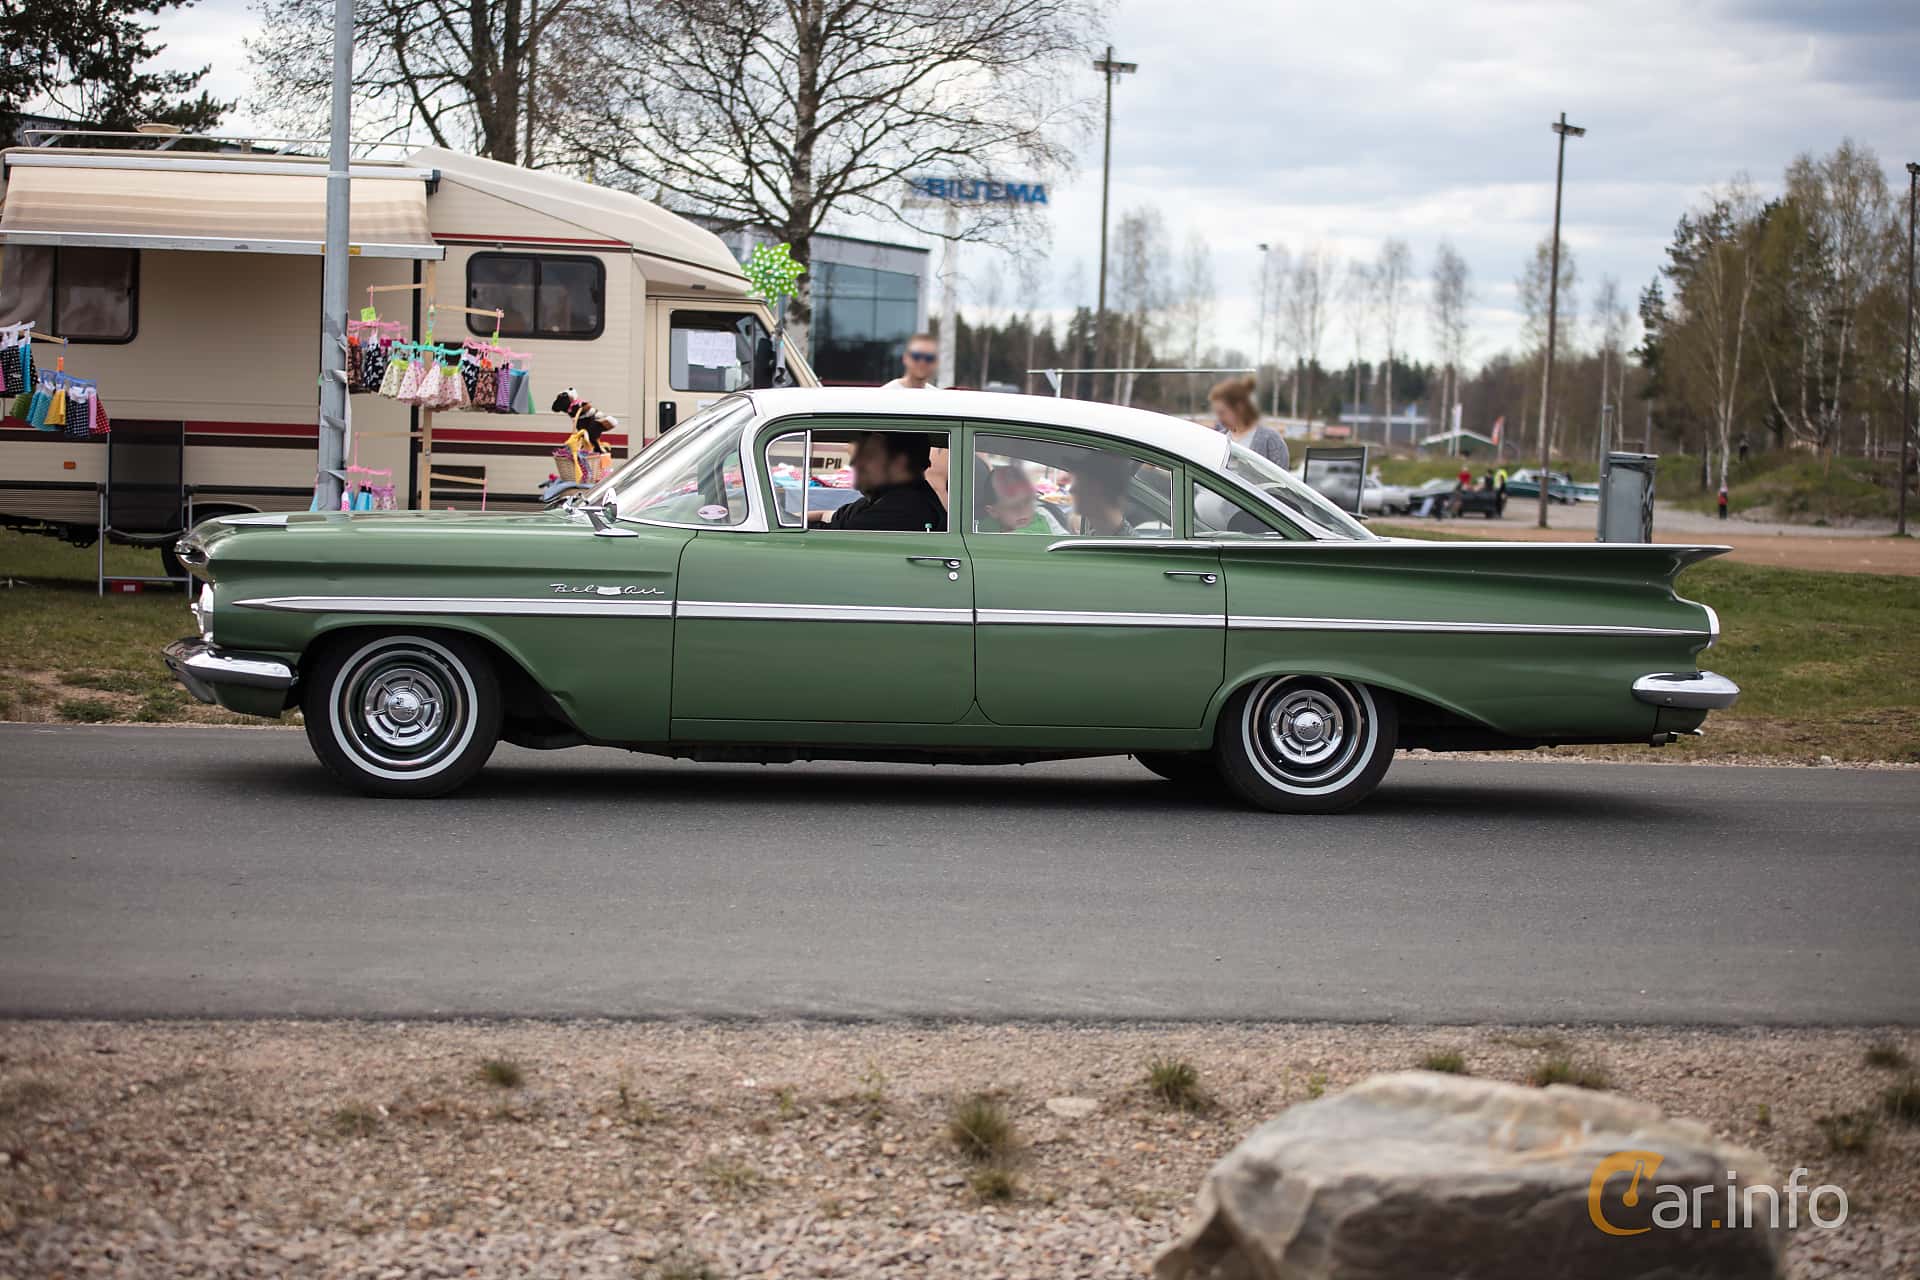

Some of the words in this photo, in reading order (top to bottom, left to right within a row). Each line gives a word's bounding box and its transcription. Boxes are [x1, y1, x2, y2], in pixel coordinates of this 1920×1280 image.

[926, 177, 1048, 204] BILTEMA
[549, 583, 595, 594] Bel
[621, 585, 665, 595] Air
